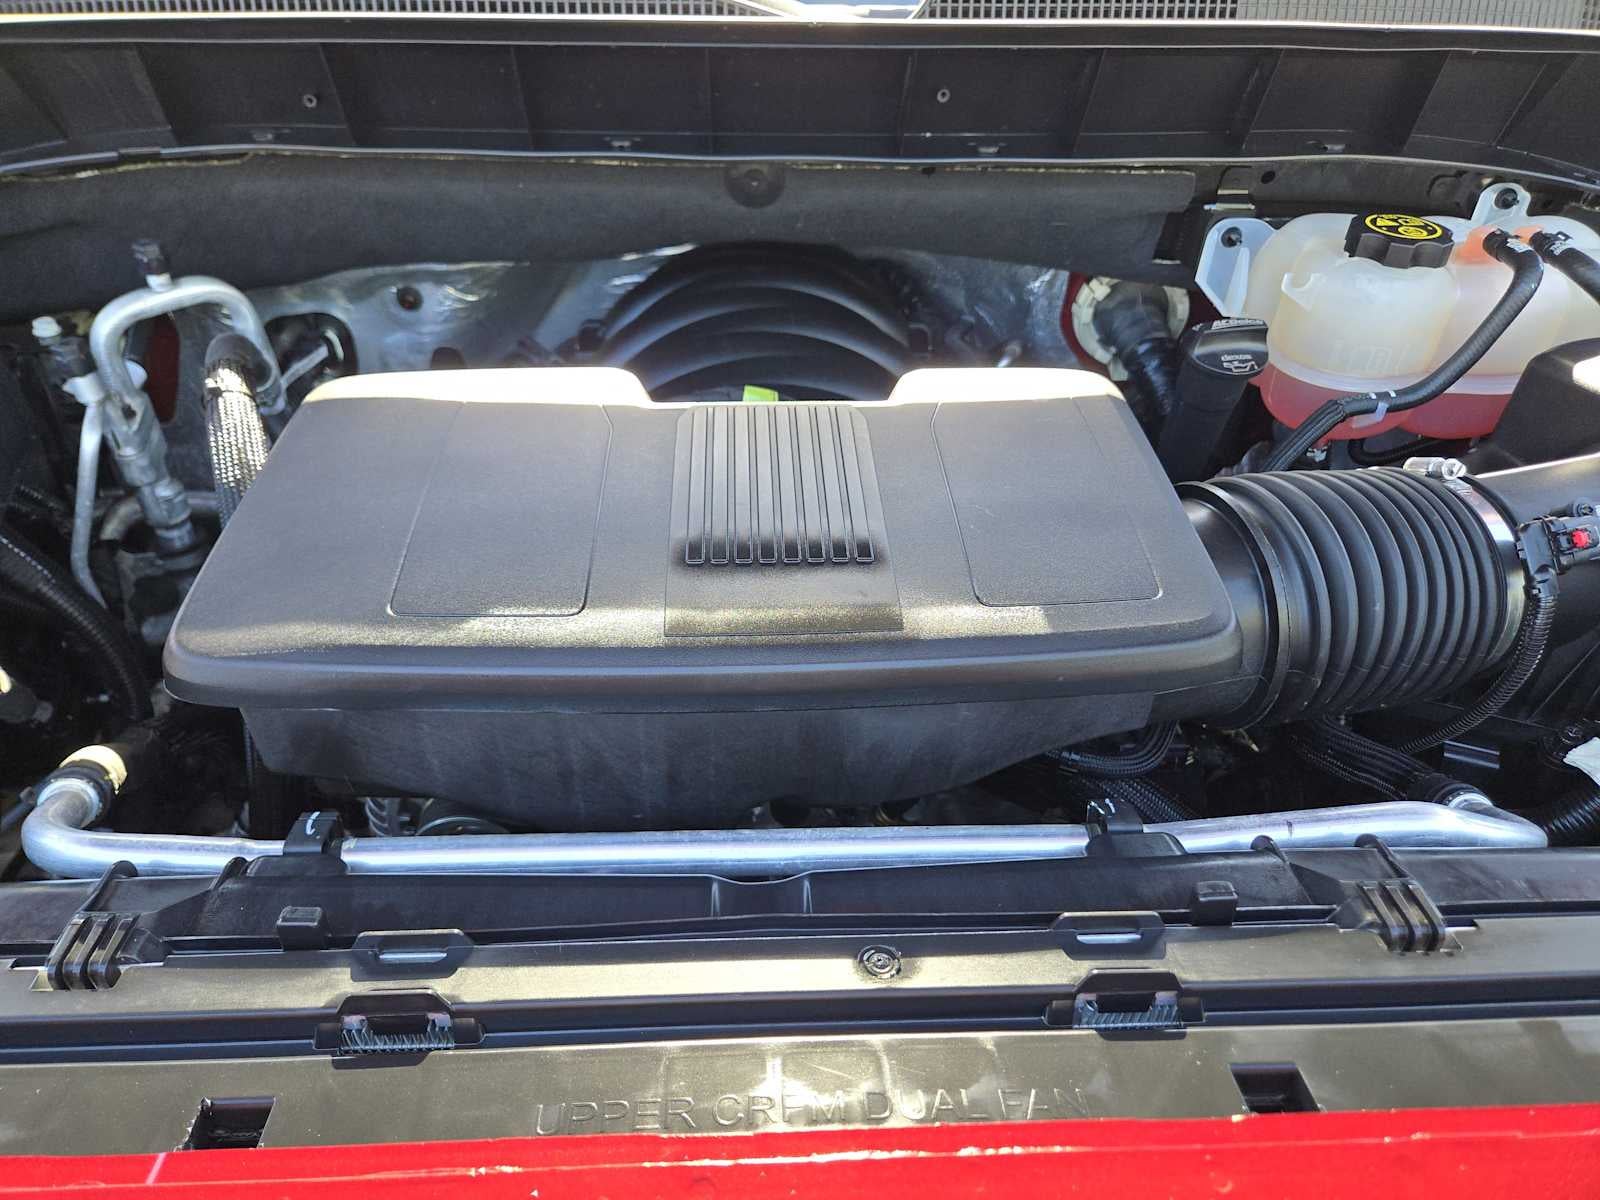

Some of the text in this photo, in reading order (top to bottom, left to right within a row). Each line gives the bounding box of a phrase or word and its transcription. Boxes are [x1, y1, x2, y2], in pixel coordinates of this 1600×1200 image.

[534, 1095, 697, 1136] UPPER
[863, 1088, 989, 1122] DUAL
[998, 1087, 1090, 1121] FAN
